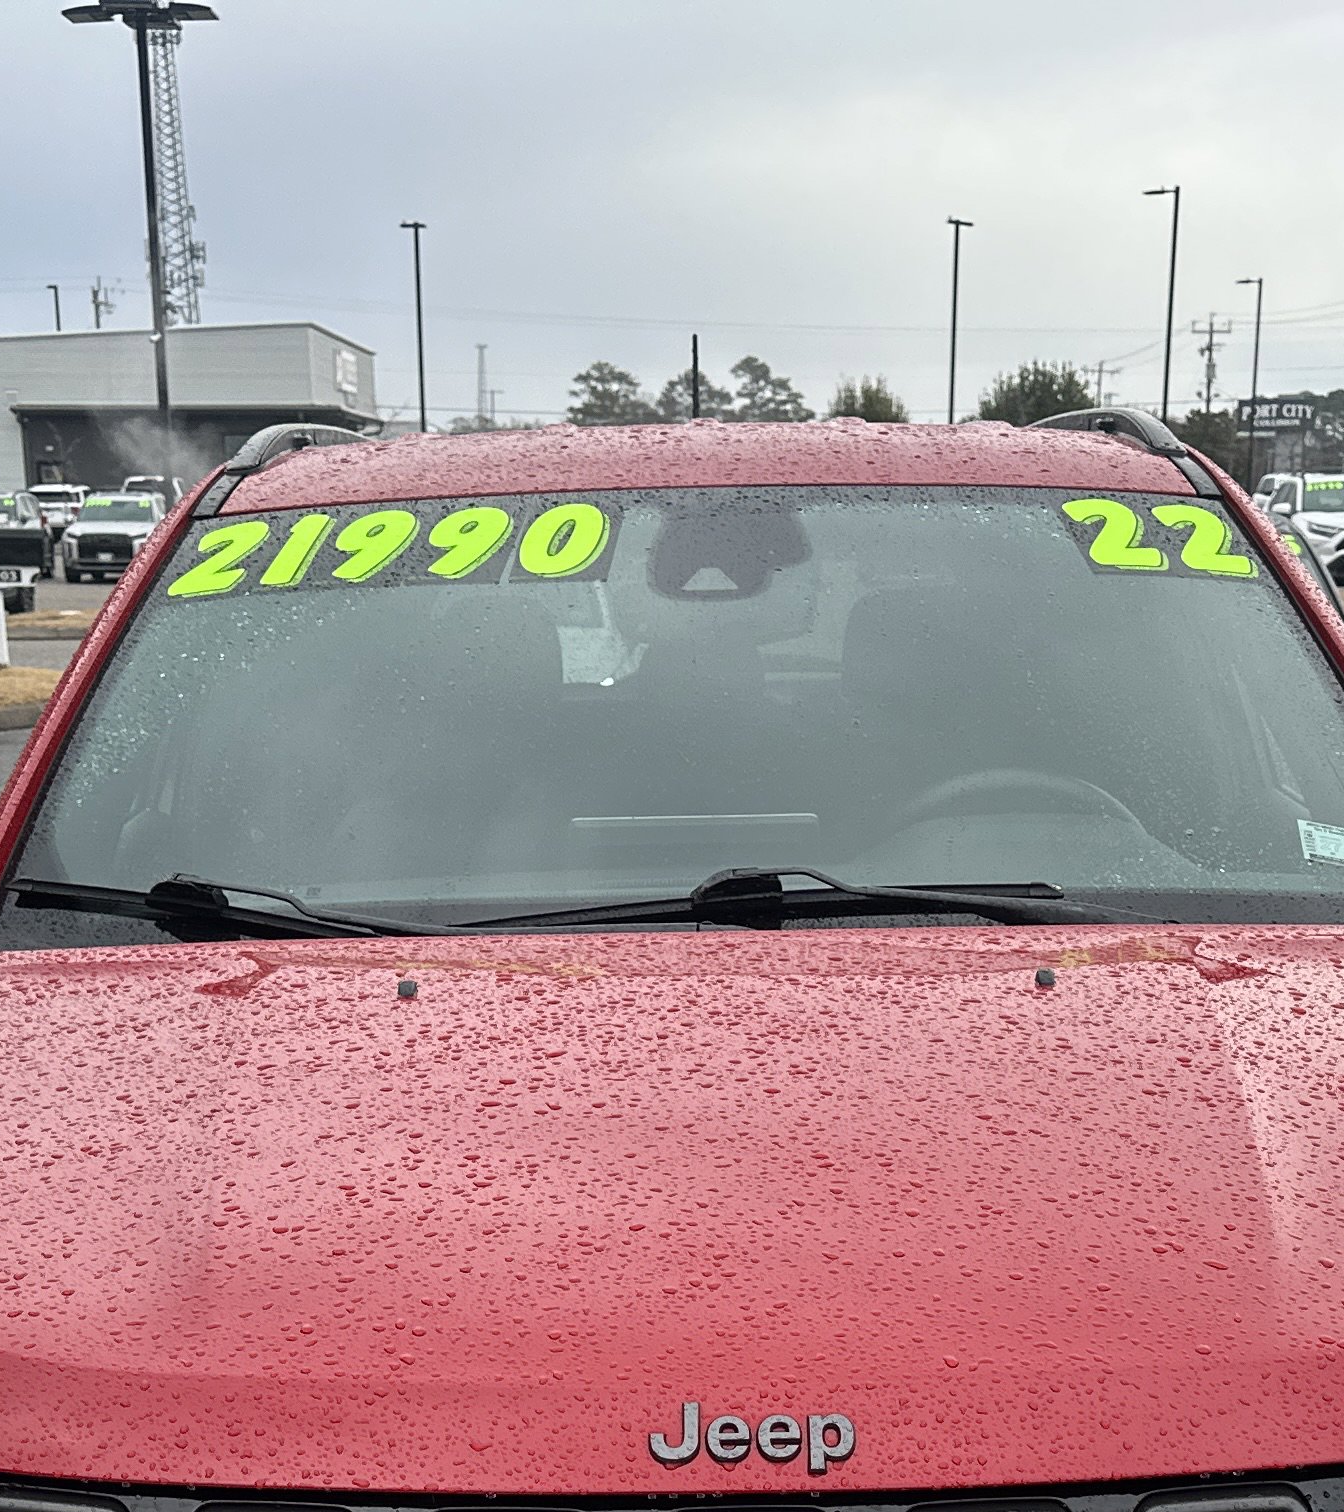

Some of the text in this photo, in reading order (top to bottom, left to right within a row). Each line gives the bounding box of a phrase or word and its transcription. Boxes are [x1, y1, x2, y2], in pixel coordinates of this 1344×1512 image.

[1282, 404, 1315, 419] CITY
[168, 503, 610, 597] 21990
[1062, 499, 1259, 579] 22
[648, 1401, 856, 1476] Jeep
